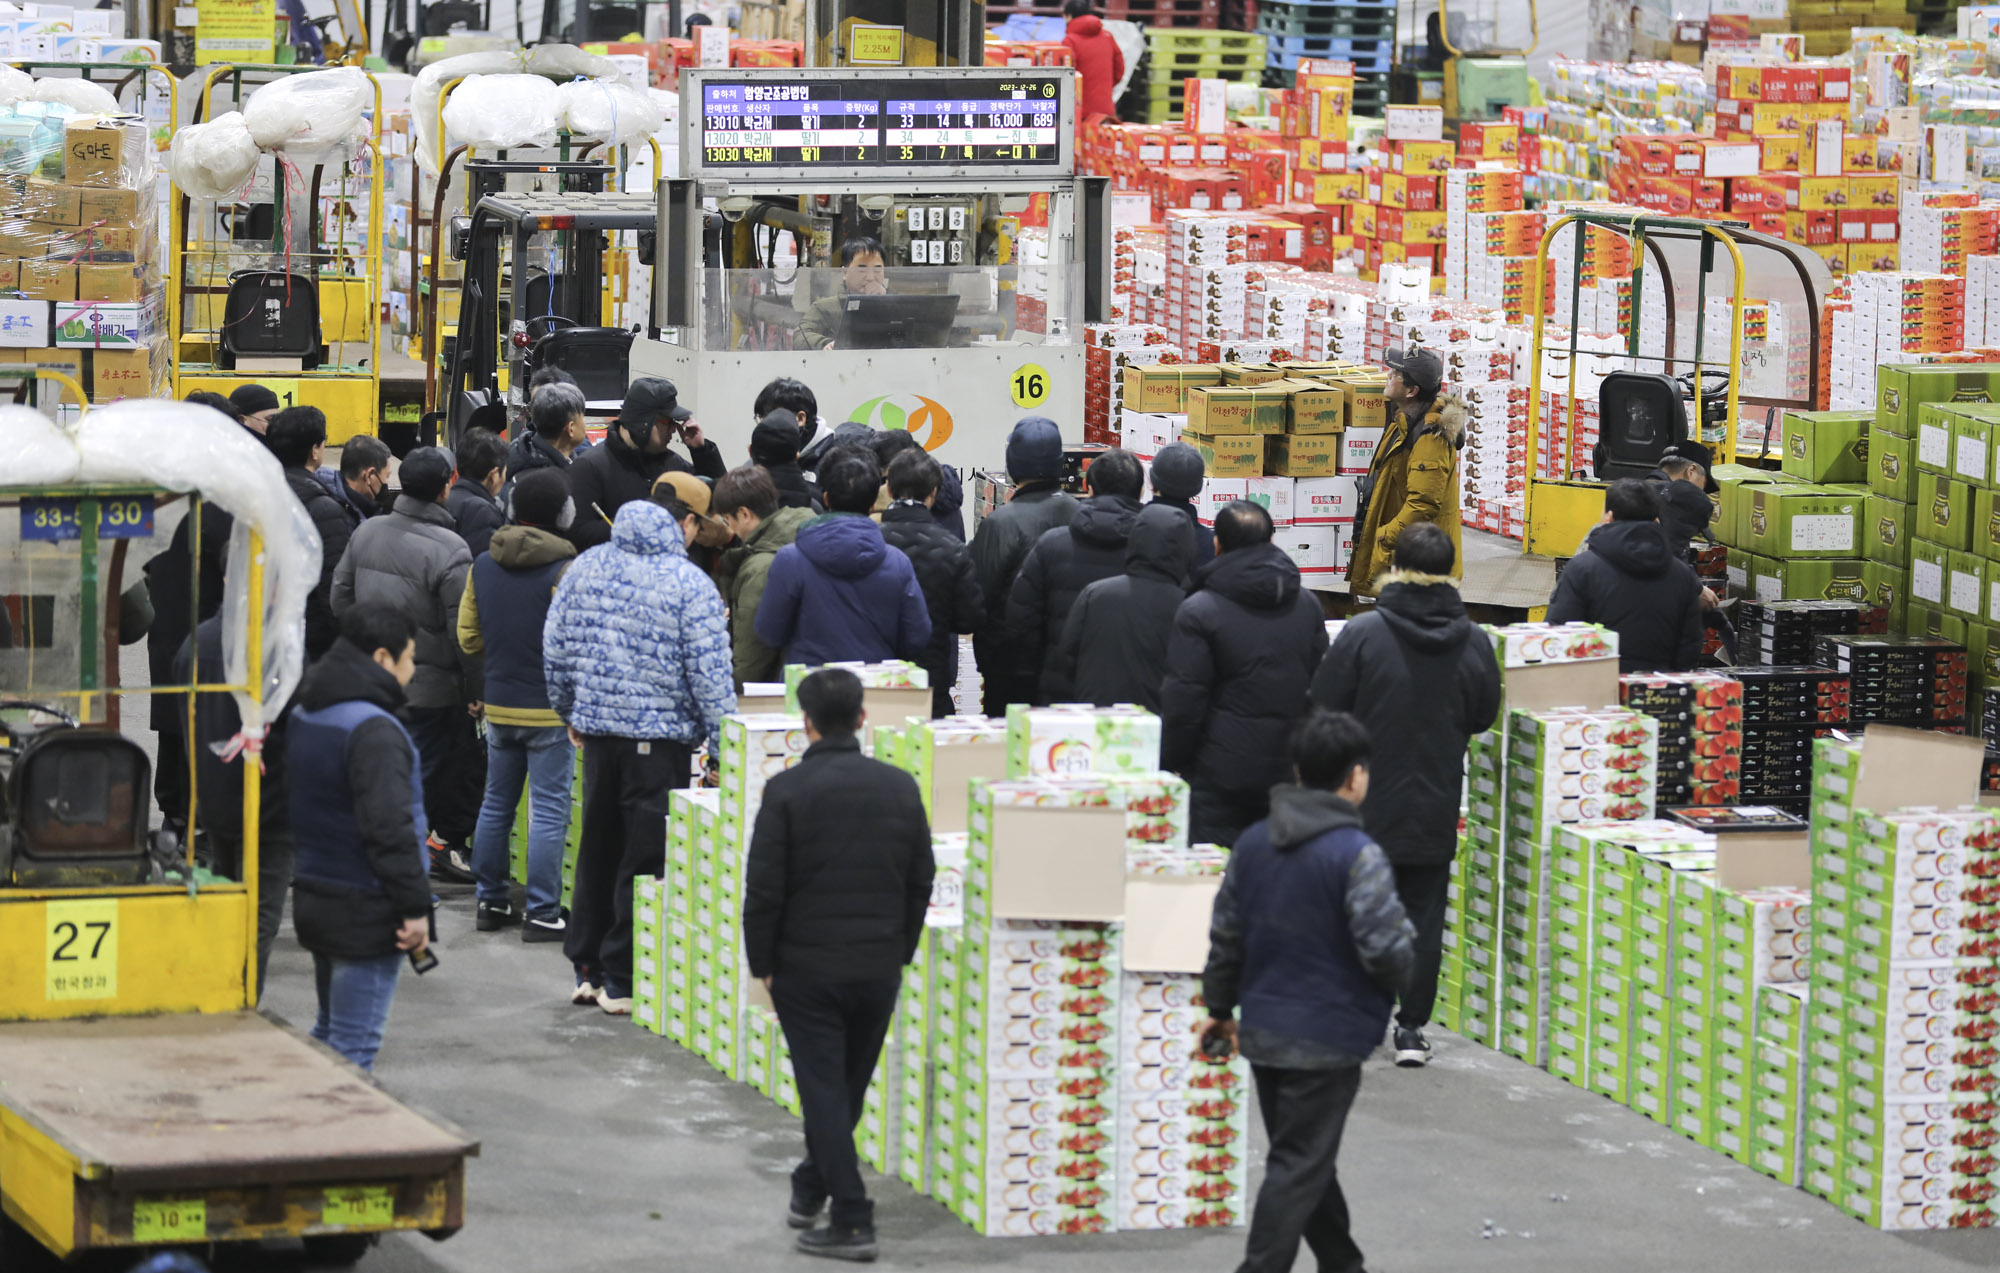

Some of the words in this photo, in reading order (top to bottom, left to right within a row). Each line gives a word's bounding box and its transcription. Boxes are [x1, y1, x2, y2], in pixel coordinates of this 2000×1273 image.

[863, 44, 891, 54] 2.25M
[712, 89, 737, 99] 출하처
[1045, 86, 1053, 95] 16
[706, 103, 739, 113] 판매번호
[746, 103, 770, 112] 생산자
[803, 103, 819, 112] 품목
[845, 103, 878, 113] 중량(Kg)
[899, 103, 915, 112] 규격
[935, 103, 951, 111] 수량
[961, 103, 977, 111] 등급
[990, 102, 1021, 111] 경락단가
[1032, 102, 1055, 111] 낙찰자
[707, 116, 739, 129] 13010
[801, 115, 820, 129] 딸기
[858, 115, 865, 128] 2
[900, 115, 914, 127] 33
[937, 114, 950, 127] 14
[964, 114, 973, 127] 특
[988, 114, 1023, 128] 16,000
[1033, 114, 1053, 127] 689
[707, 132, 739, 145] 13020
[801, 131, 820, 145] 딸기
[858, 131, 865, 143] 2
[901, 131, 913, 143] 34
[937, 131, 949, 143] 24
[965, 131, 973, 143] 특
[73, 142, 113, 160] G마트
[707, 148, 739, 161] 13030
[801, 147, 820, 161] 딸기
[857, 146, 865, 160] 2
[900, 146, 913, 159] 35
[939, 146, 946, 159] 7
[964, 145, 973, 159] 특
[1015, 374, 1043, 399] 16
[1357, 398, 1386, 408] 이천청
[108, 501, 142, 525] 30
[53, 921, 111, 962] 27
[160, 1211, 179, 1228] 10
